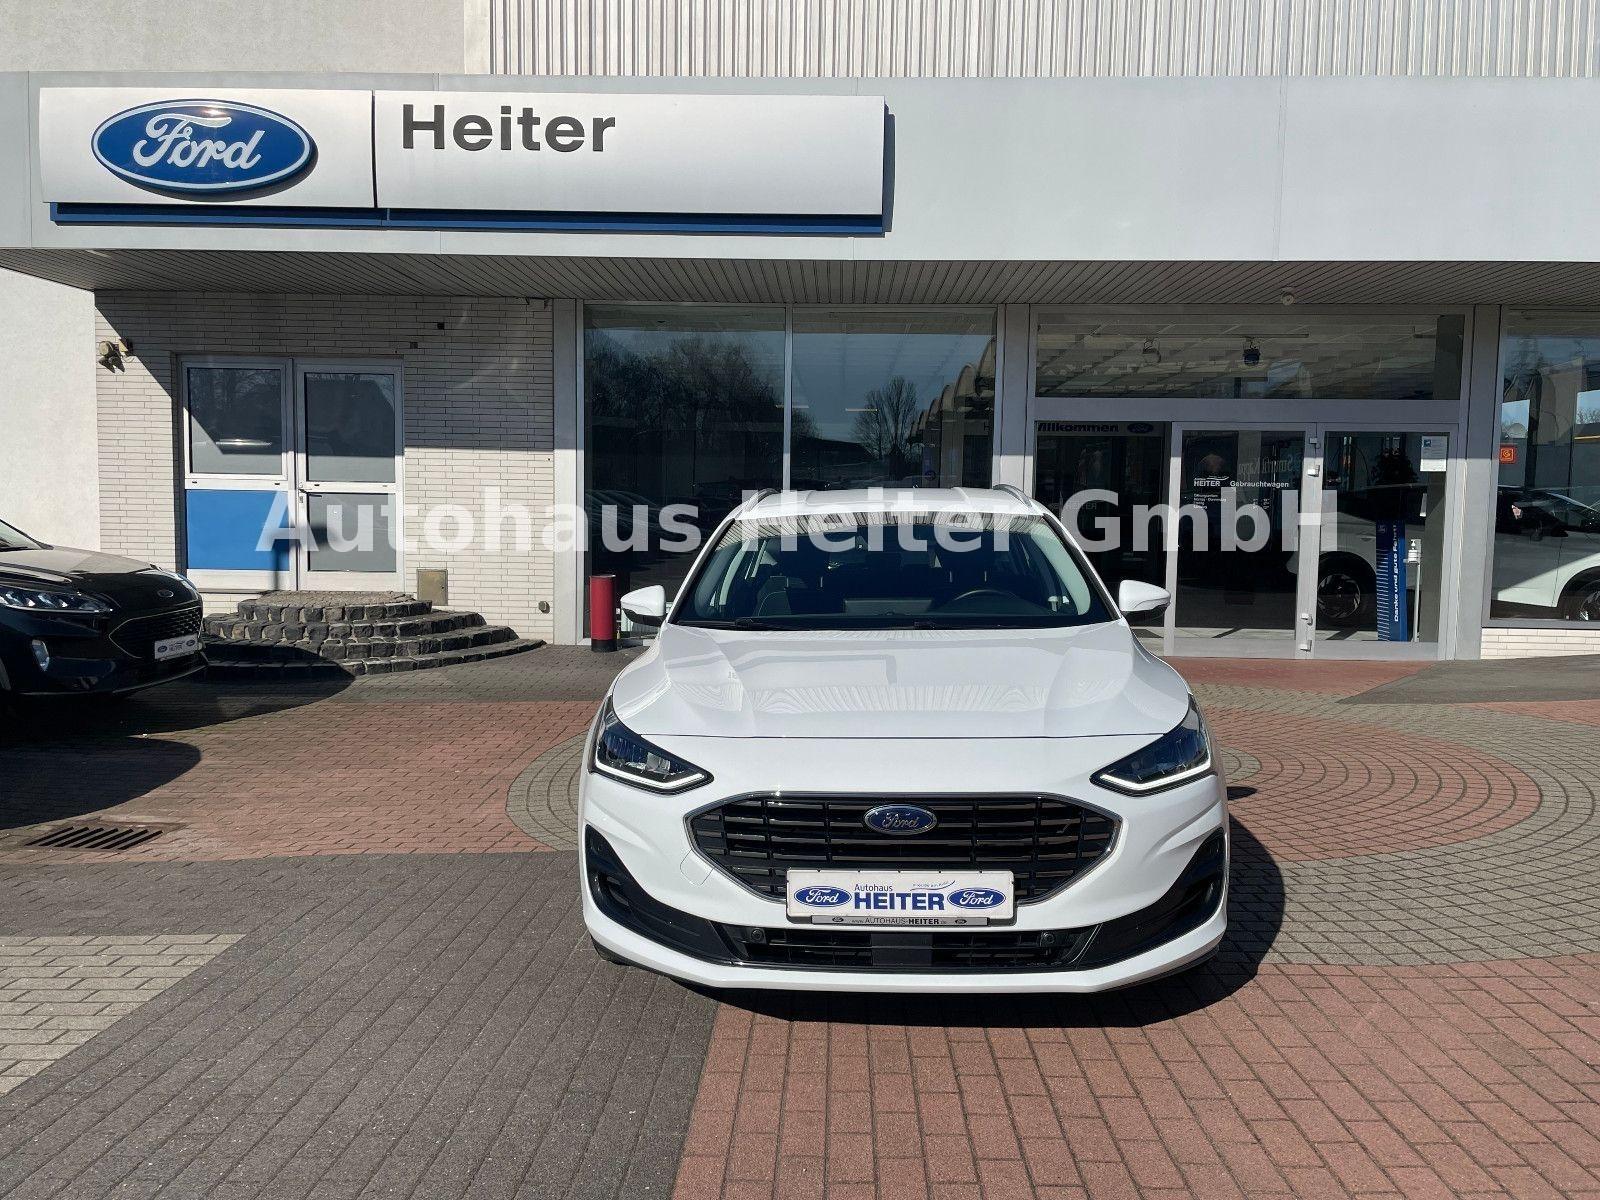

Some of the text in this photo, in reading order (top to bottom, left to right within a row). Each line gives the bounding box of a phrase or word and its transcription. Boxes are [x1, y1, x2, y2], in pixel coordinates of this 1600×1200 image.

[402, 104, 616, 152] Heiter
[132, 113, 264, 170] Ford
[1229, 480, 1289, 489] Gebrauchtwagen
[881, 812, 919, 828] Ford
[854, 883, 894, 892] Autohaus
[805, 888, 839, 903] Ford
[854, 892, 945, 910] HEITER
[959, 890, 994, 905] Ford
